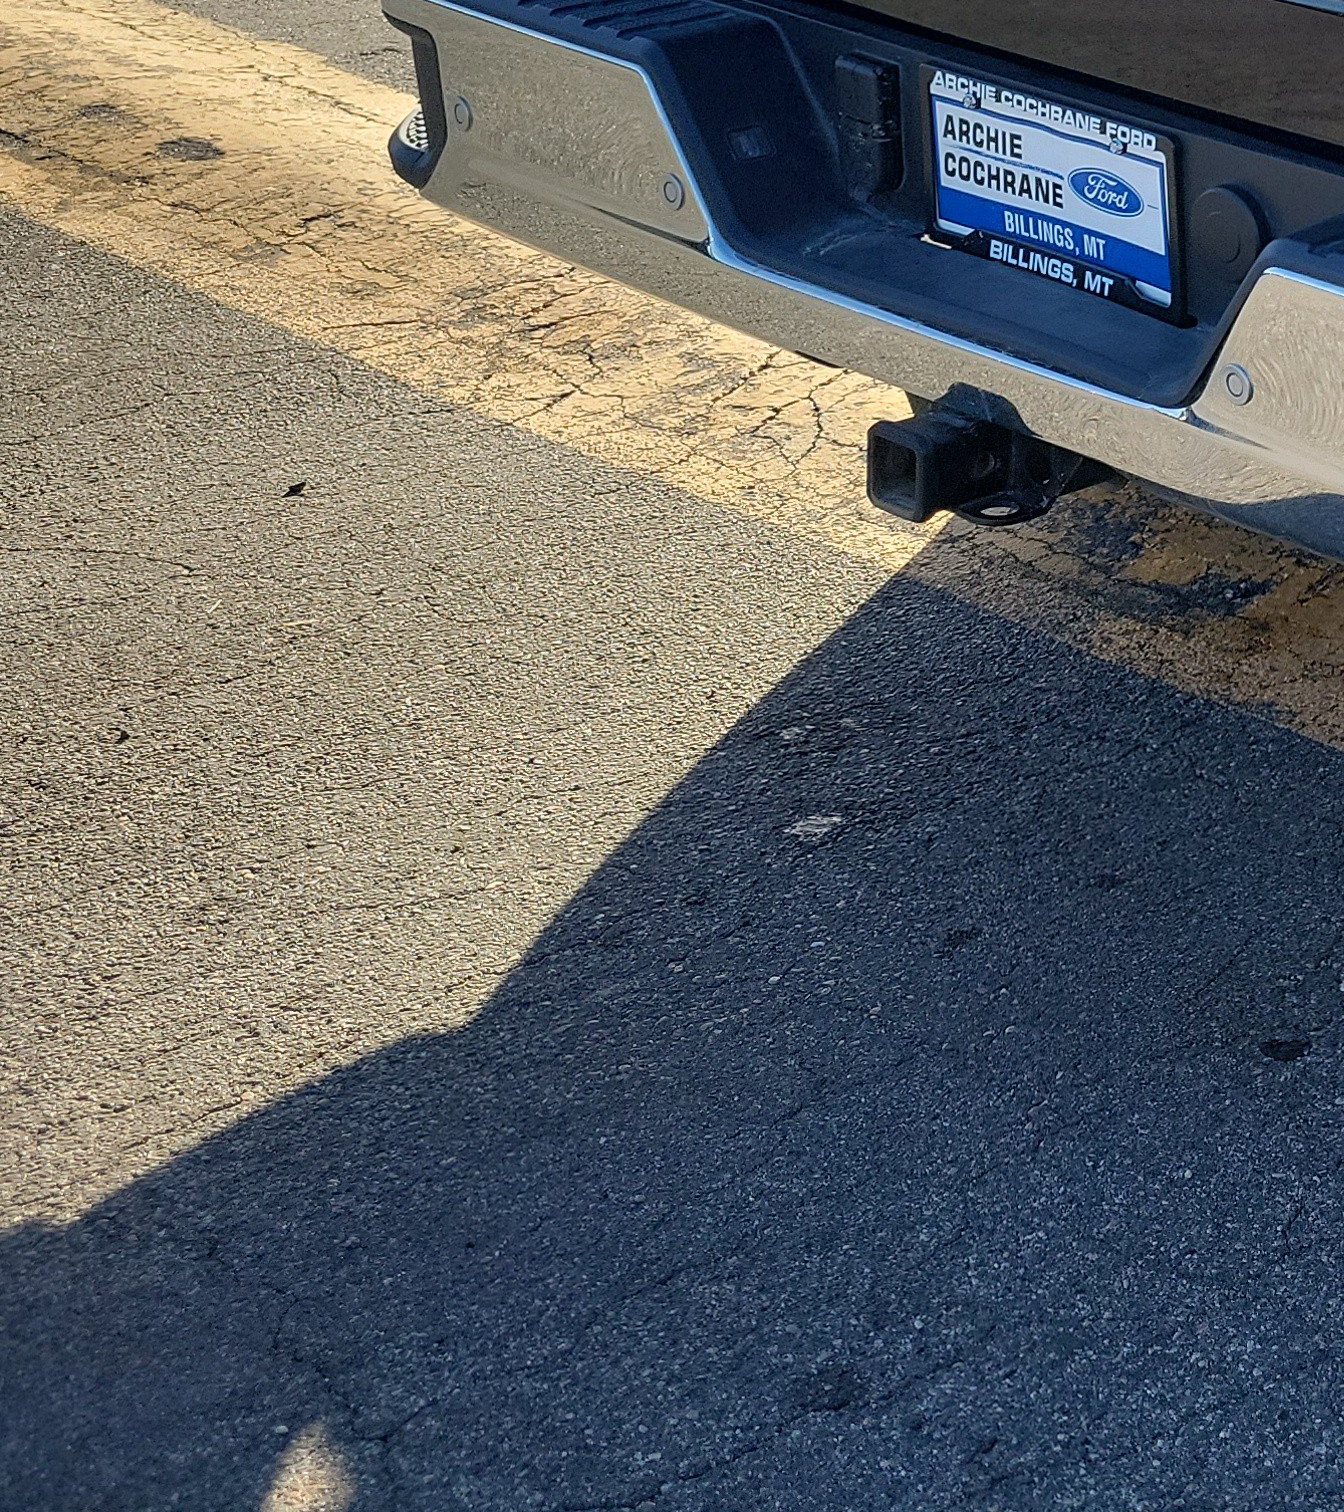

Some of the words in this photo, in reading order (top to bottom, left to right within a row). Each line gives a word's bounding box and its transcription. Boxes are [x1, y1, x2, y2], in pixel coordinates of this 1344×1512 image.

[931, 69, 998, 101] ARCHIE
[999, 91, 1102, 133] COCHRANE
[1105, 120, 1157, 152] FORD
[942, 113, 1023, 160] ARCHIE
[943, 151, 1064, 209] COCHRANE
[1082, 172, 1130, 211] Ford
[1003, 210, 1080, 256] BILLINGS,
[1083, 234, 1106, 262] MT
[989, 239, 1078, 288] BILLINGS,
[1083, 270, 1115, 297] MT
